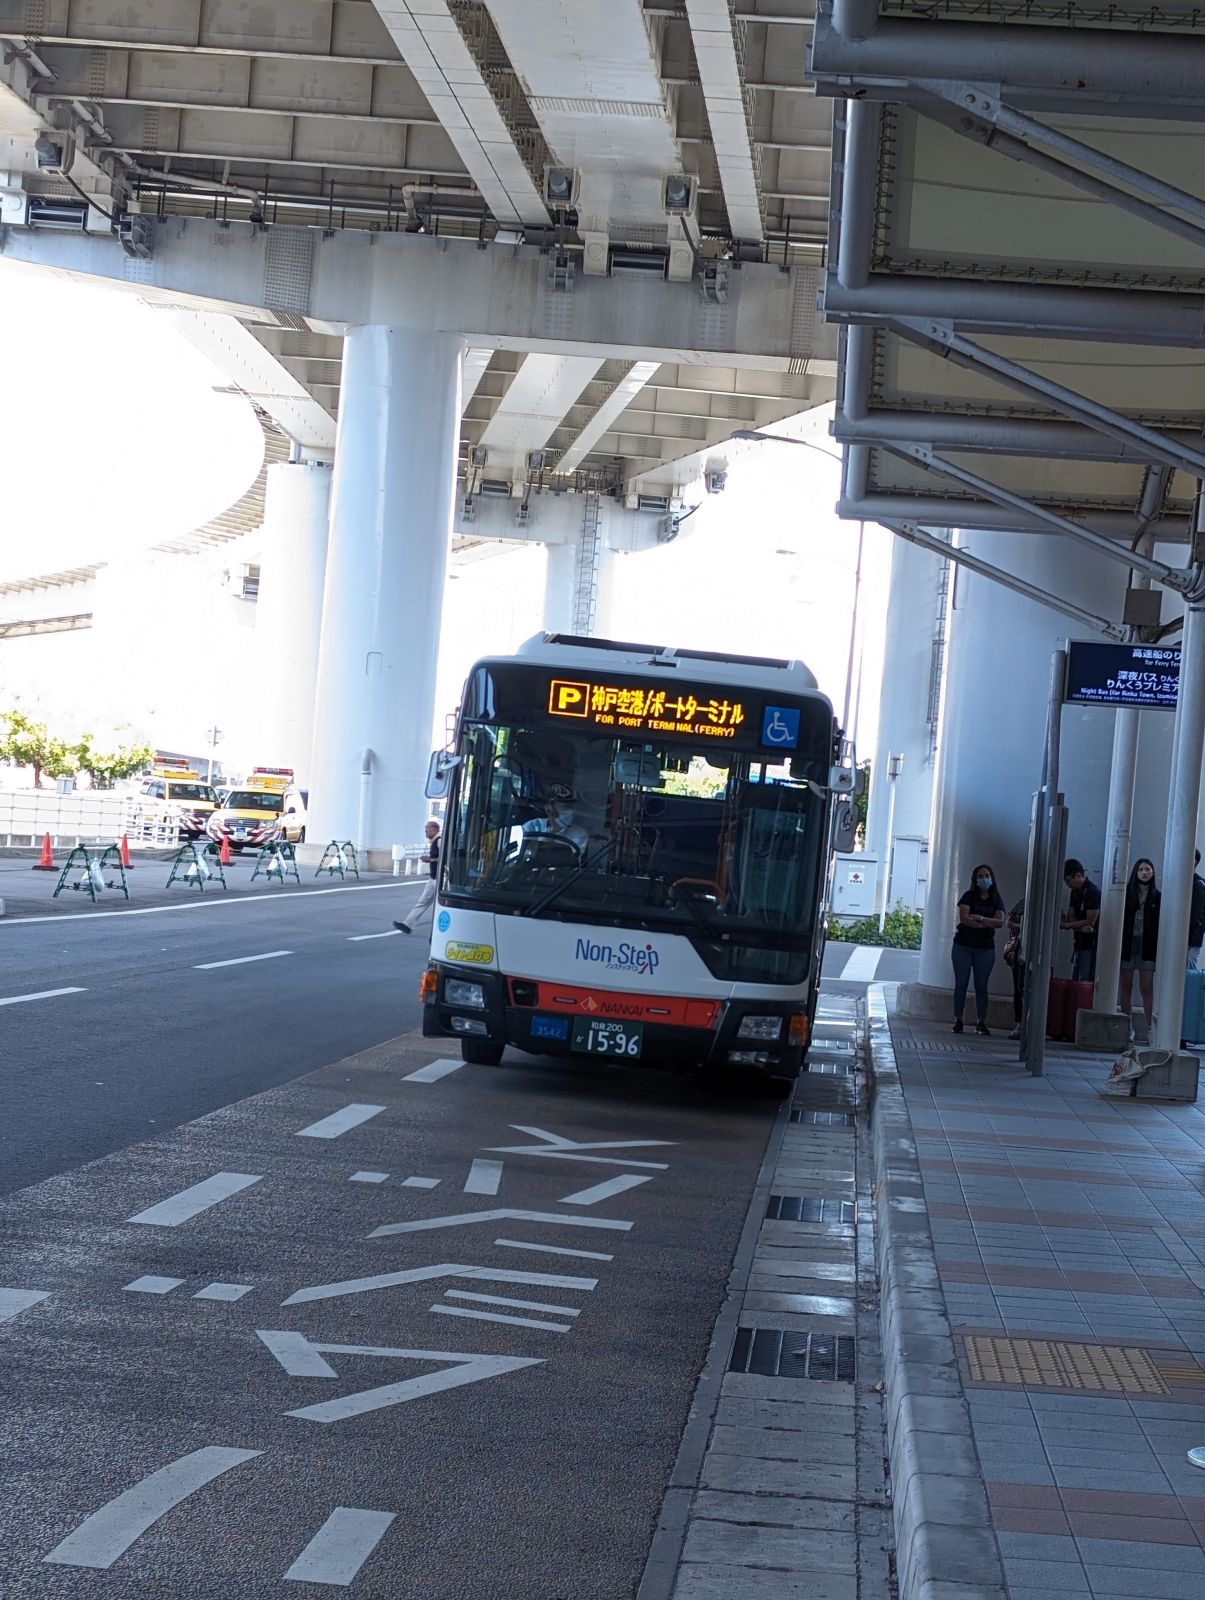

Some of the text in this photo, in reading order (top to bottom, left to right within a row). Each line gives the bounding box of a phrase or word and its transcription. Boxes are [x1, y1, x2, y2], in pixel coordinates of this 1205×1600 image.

[1154, 660, 1170, 668] Ferry
[1117, 670, 1158, 682] 深夜バス
[1080, 687, 1097, 695] Night
[591, 685, 744, 725] 神戸空港/ポートターミナル
[595, 714, 614, 724] FOR
[618, 716, 643, 727] PORT
[575, 938, 660, 976] Non-Step
[599, 1001, 644, 1016] NANKAI
[587, 1029, 640, 1055] 15-96
